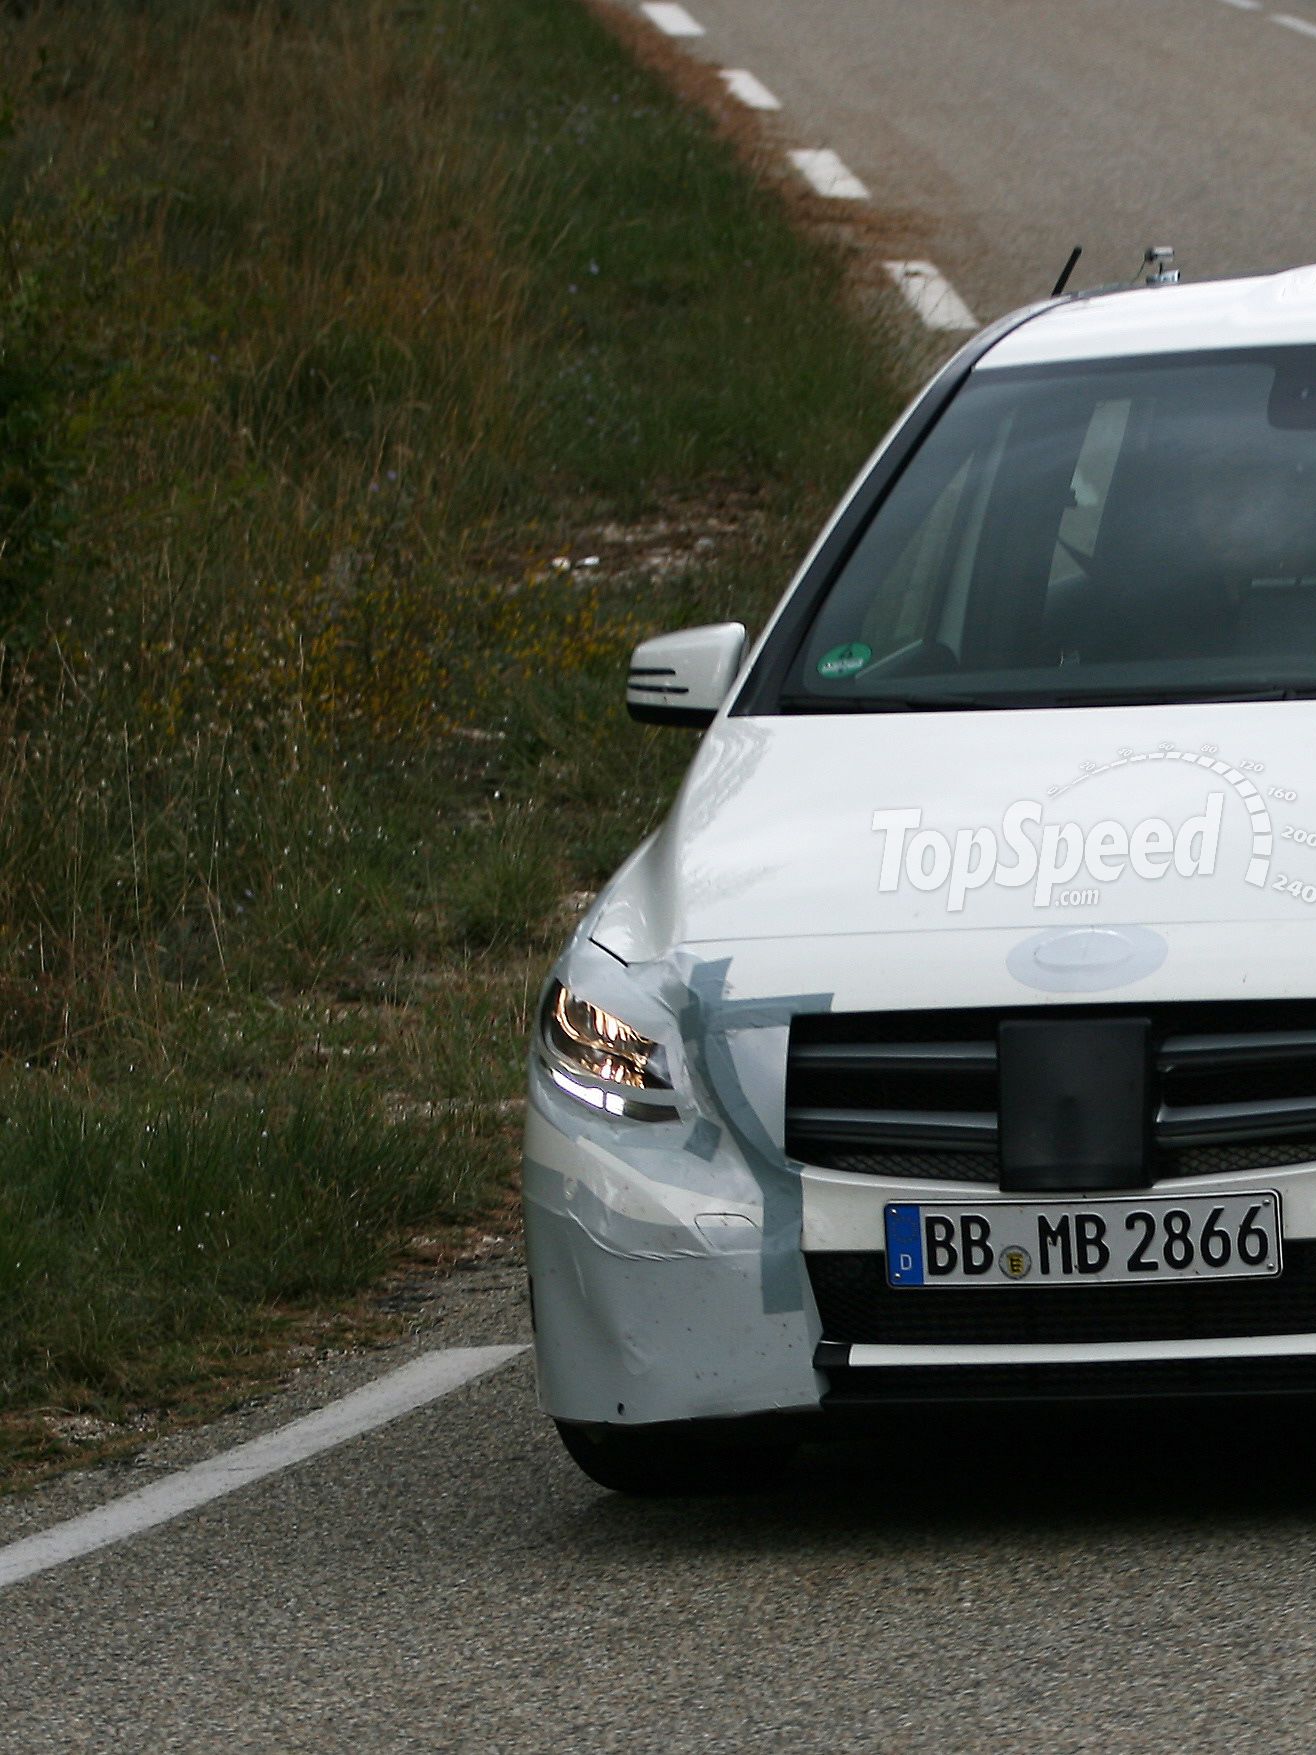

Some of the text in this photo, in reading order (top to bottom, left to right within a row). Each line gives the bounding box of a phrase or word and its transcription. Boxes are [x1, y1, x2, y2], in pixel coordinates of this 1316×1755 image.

[900, 1254, 912, 1271] D
[925, 1205, 1269, 1276] BB MB 2866
